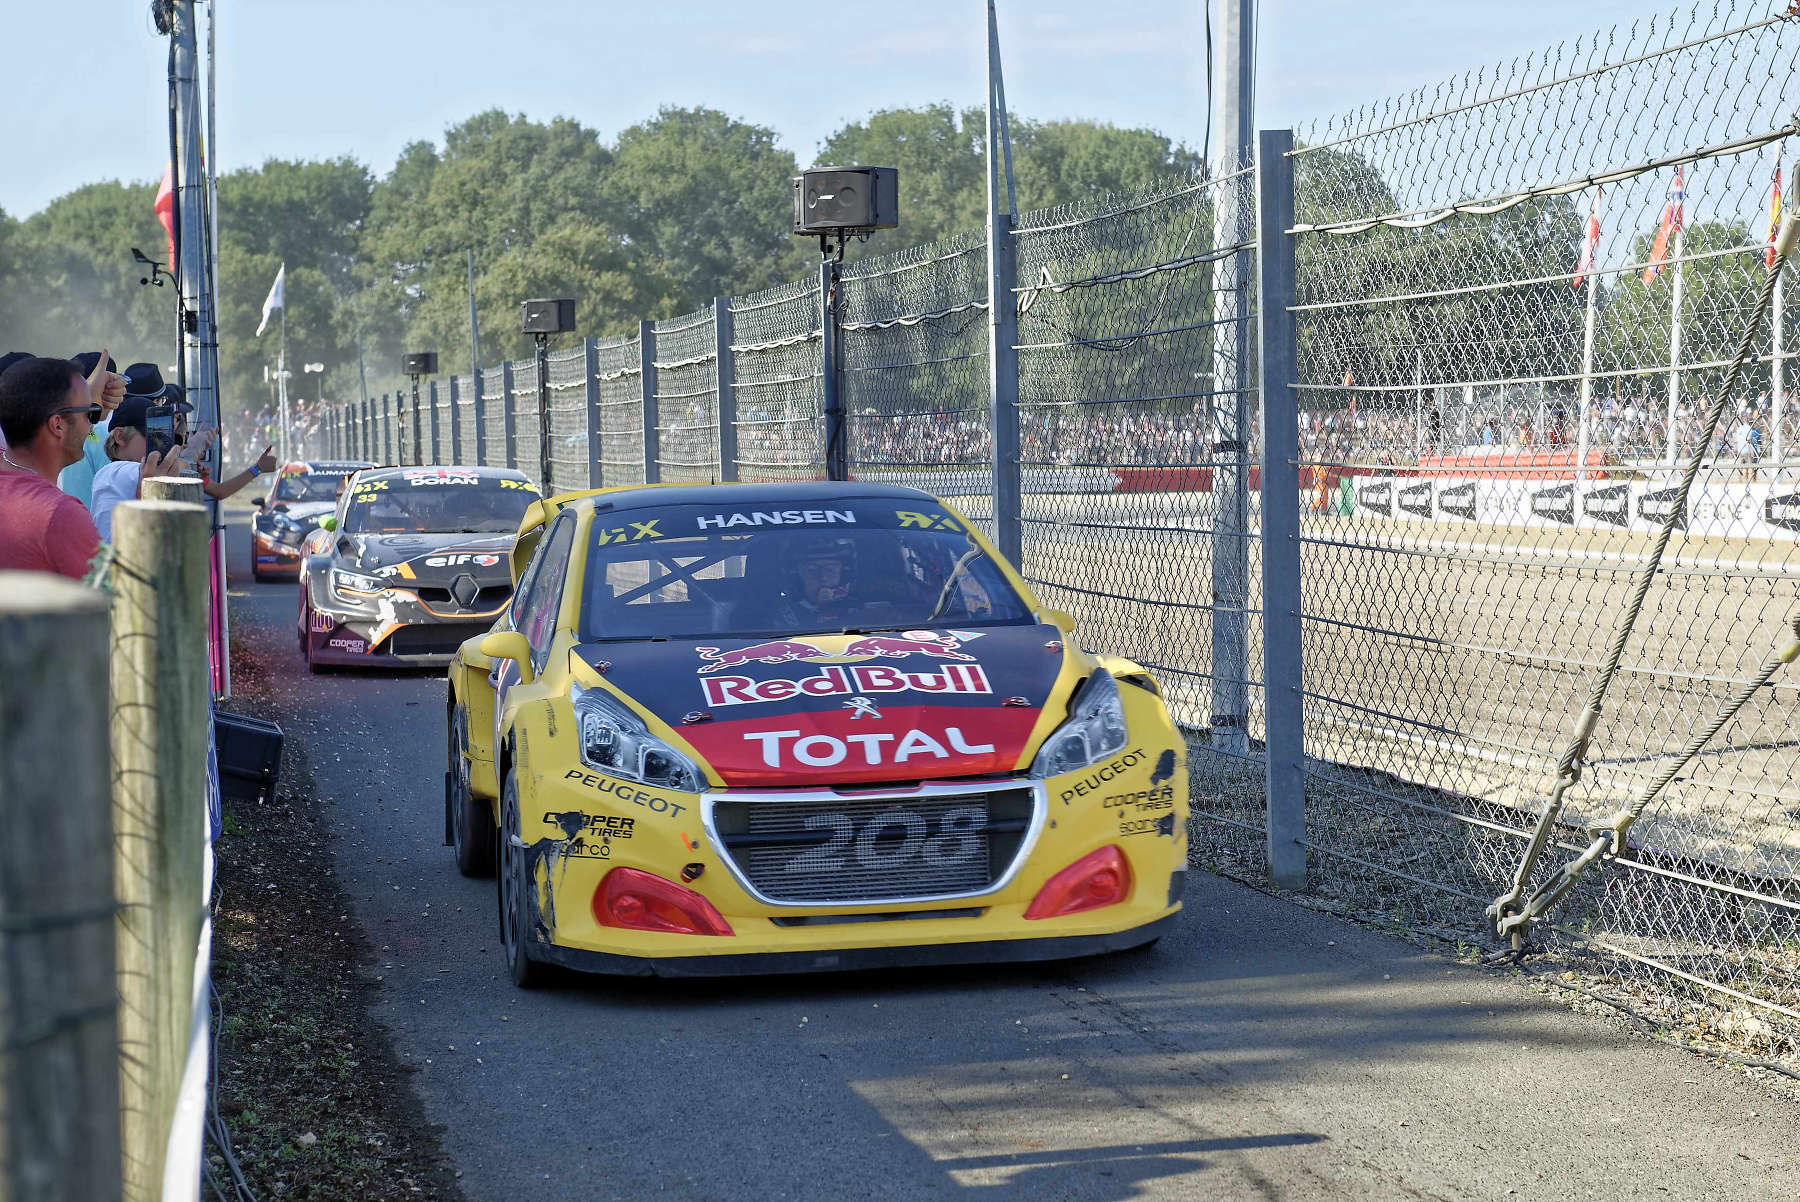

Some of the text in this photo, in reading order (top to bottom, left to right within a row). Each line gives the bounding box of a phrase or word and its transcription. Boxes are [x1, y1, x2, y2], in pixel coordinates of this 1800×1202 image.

[410, 478, 479, 486] DORAN
[356, 493, 378, 503] 33
[696, 510, 857, 530] HANSEN
[425, 554, 472, 567] elf
[329, 639, 365, 647] COOPER
[700, 664, 993, 708] Red Bull
[743, 727, 996, 768] TOTAL
[1060, 748, 1147, 806] PEUGEOT
[564, 769, 687, 819] PEUGEOT
[1103, 787, 1173, 808] COOPER
[1136, 800, 1173, 812] TIRES
[542, 810, 635, 830] COPER
[589, 827, 633, 839] TIRES
[784, 807, 988, 872] 208
